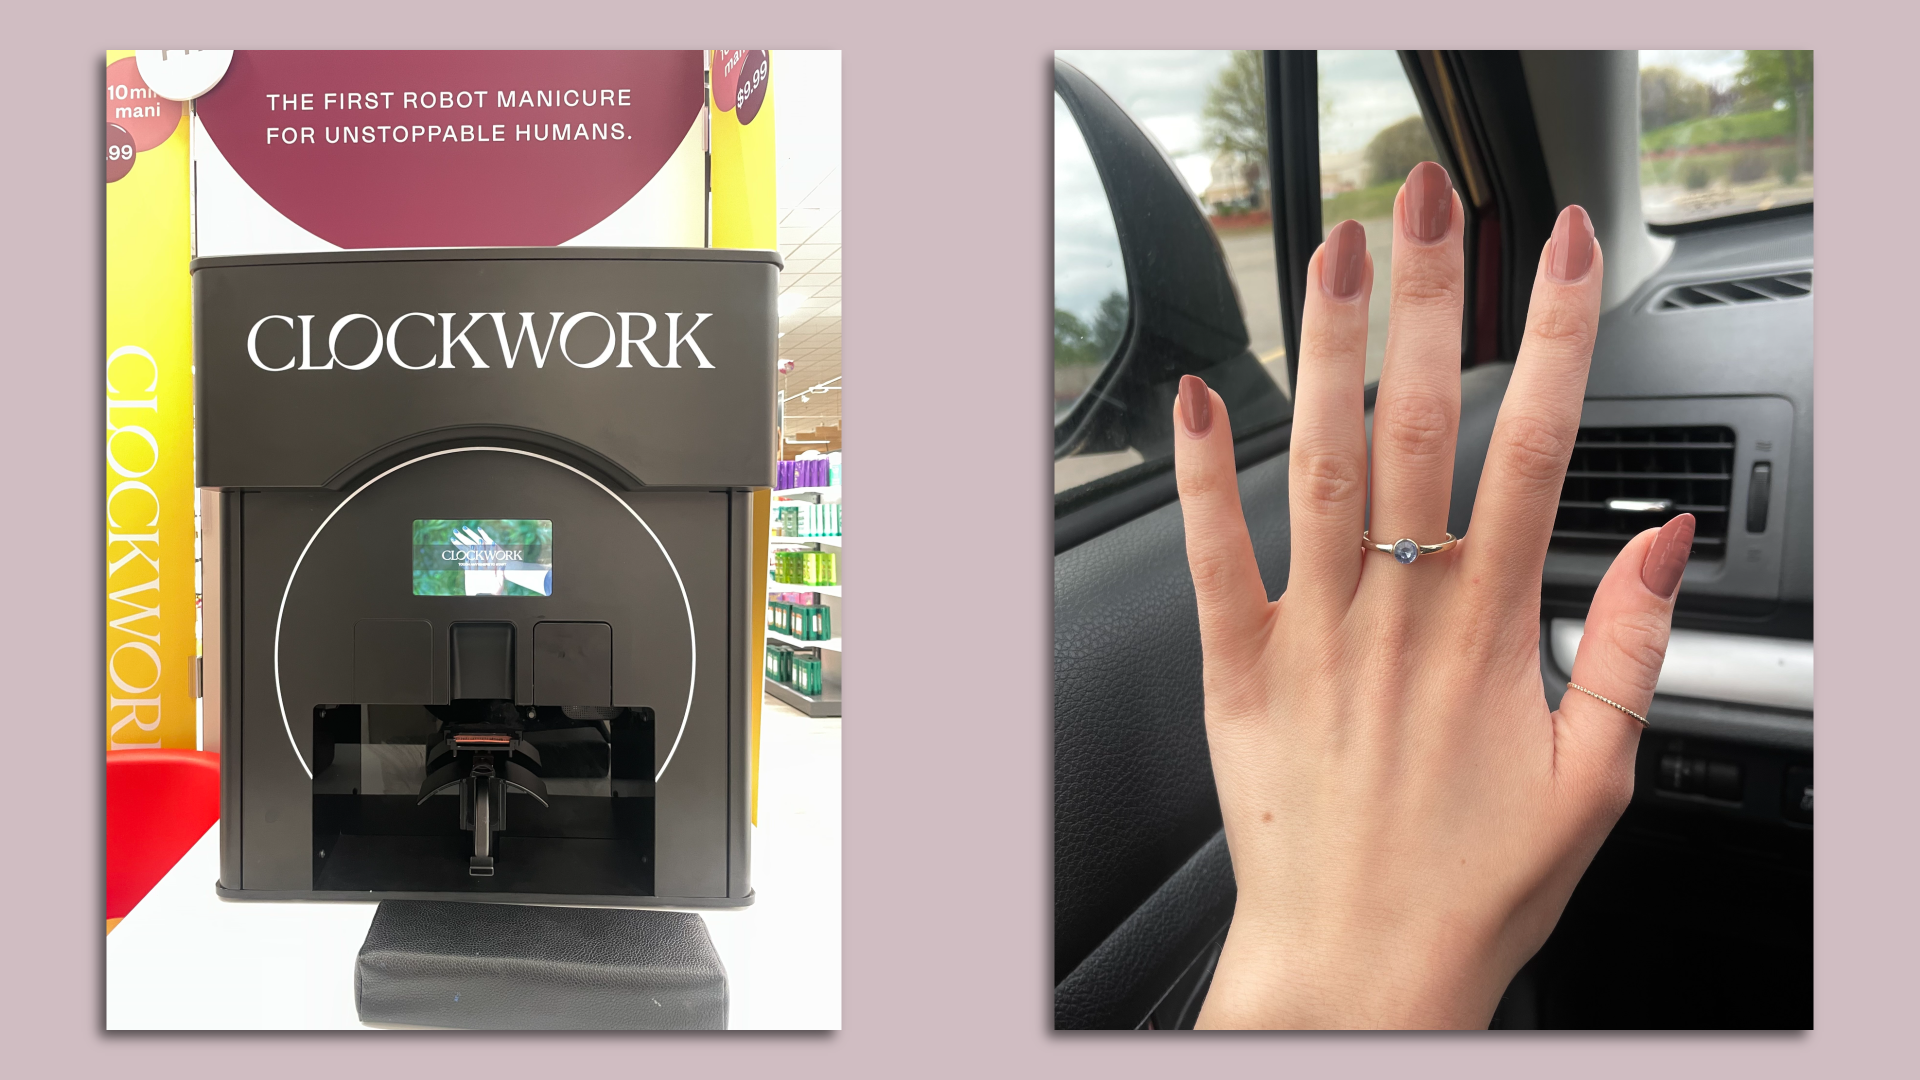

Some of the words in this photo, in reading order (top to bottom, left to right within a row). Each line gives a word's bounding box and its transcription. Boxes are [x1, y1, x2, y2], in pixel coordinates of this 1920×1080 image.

[737, 60, 768, 110] $9.99
[115, 102, 161, 119] mani
[266, 93, 314, 111] THE
[324, 92, 395, 110] FIRST
[403, 90, 488, 109] ROBOT
[497, 88, 632, 107] MANICURE
[266, 126, 316, 144] FOR
[325, 124, 505, 144] UNSTOPPABLE
[515, 122, 633, 142] HUMANS.
[247, 311, 716, 372] CLOCKWORK
[106, 345, 162, 751] CLOCKWOR
[441, 549, 523, 561] CLOCKWORK
